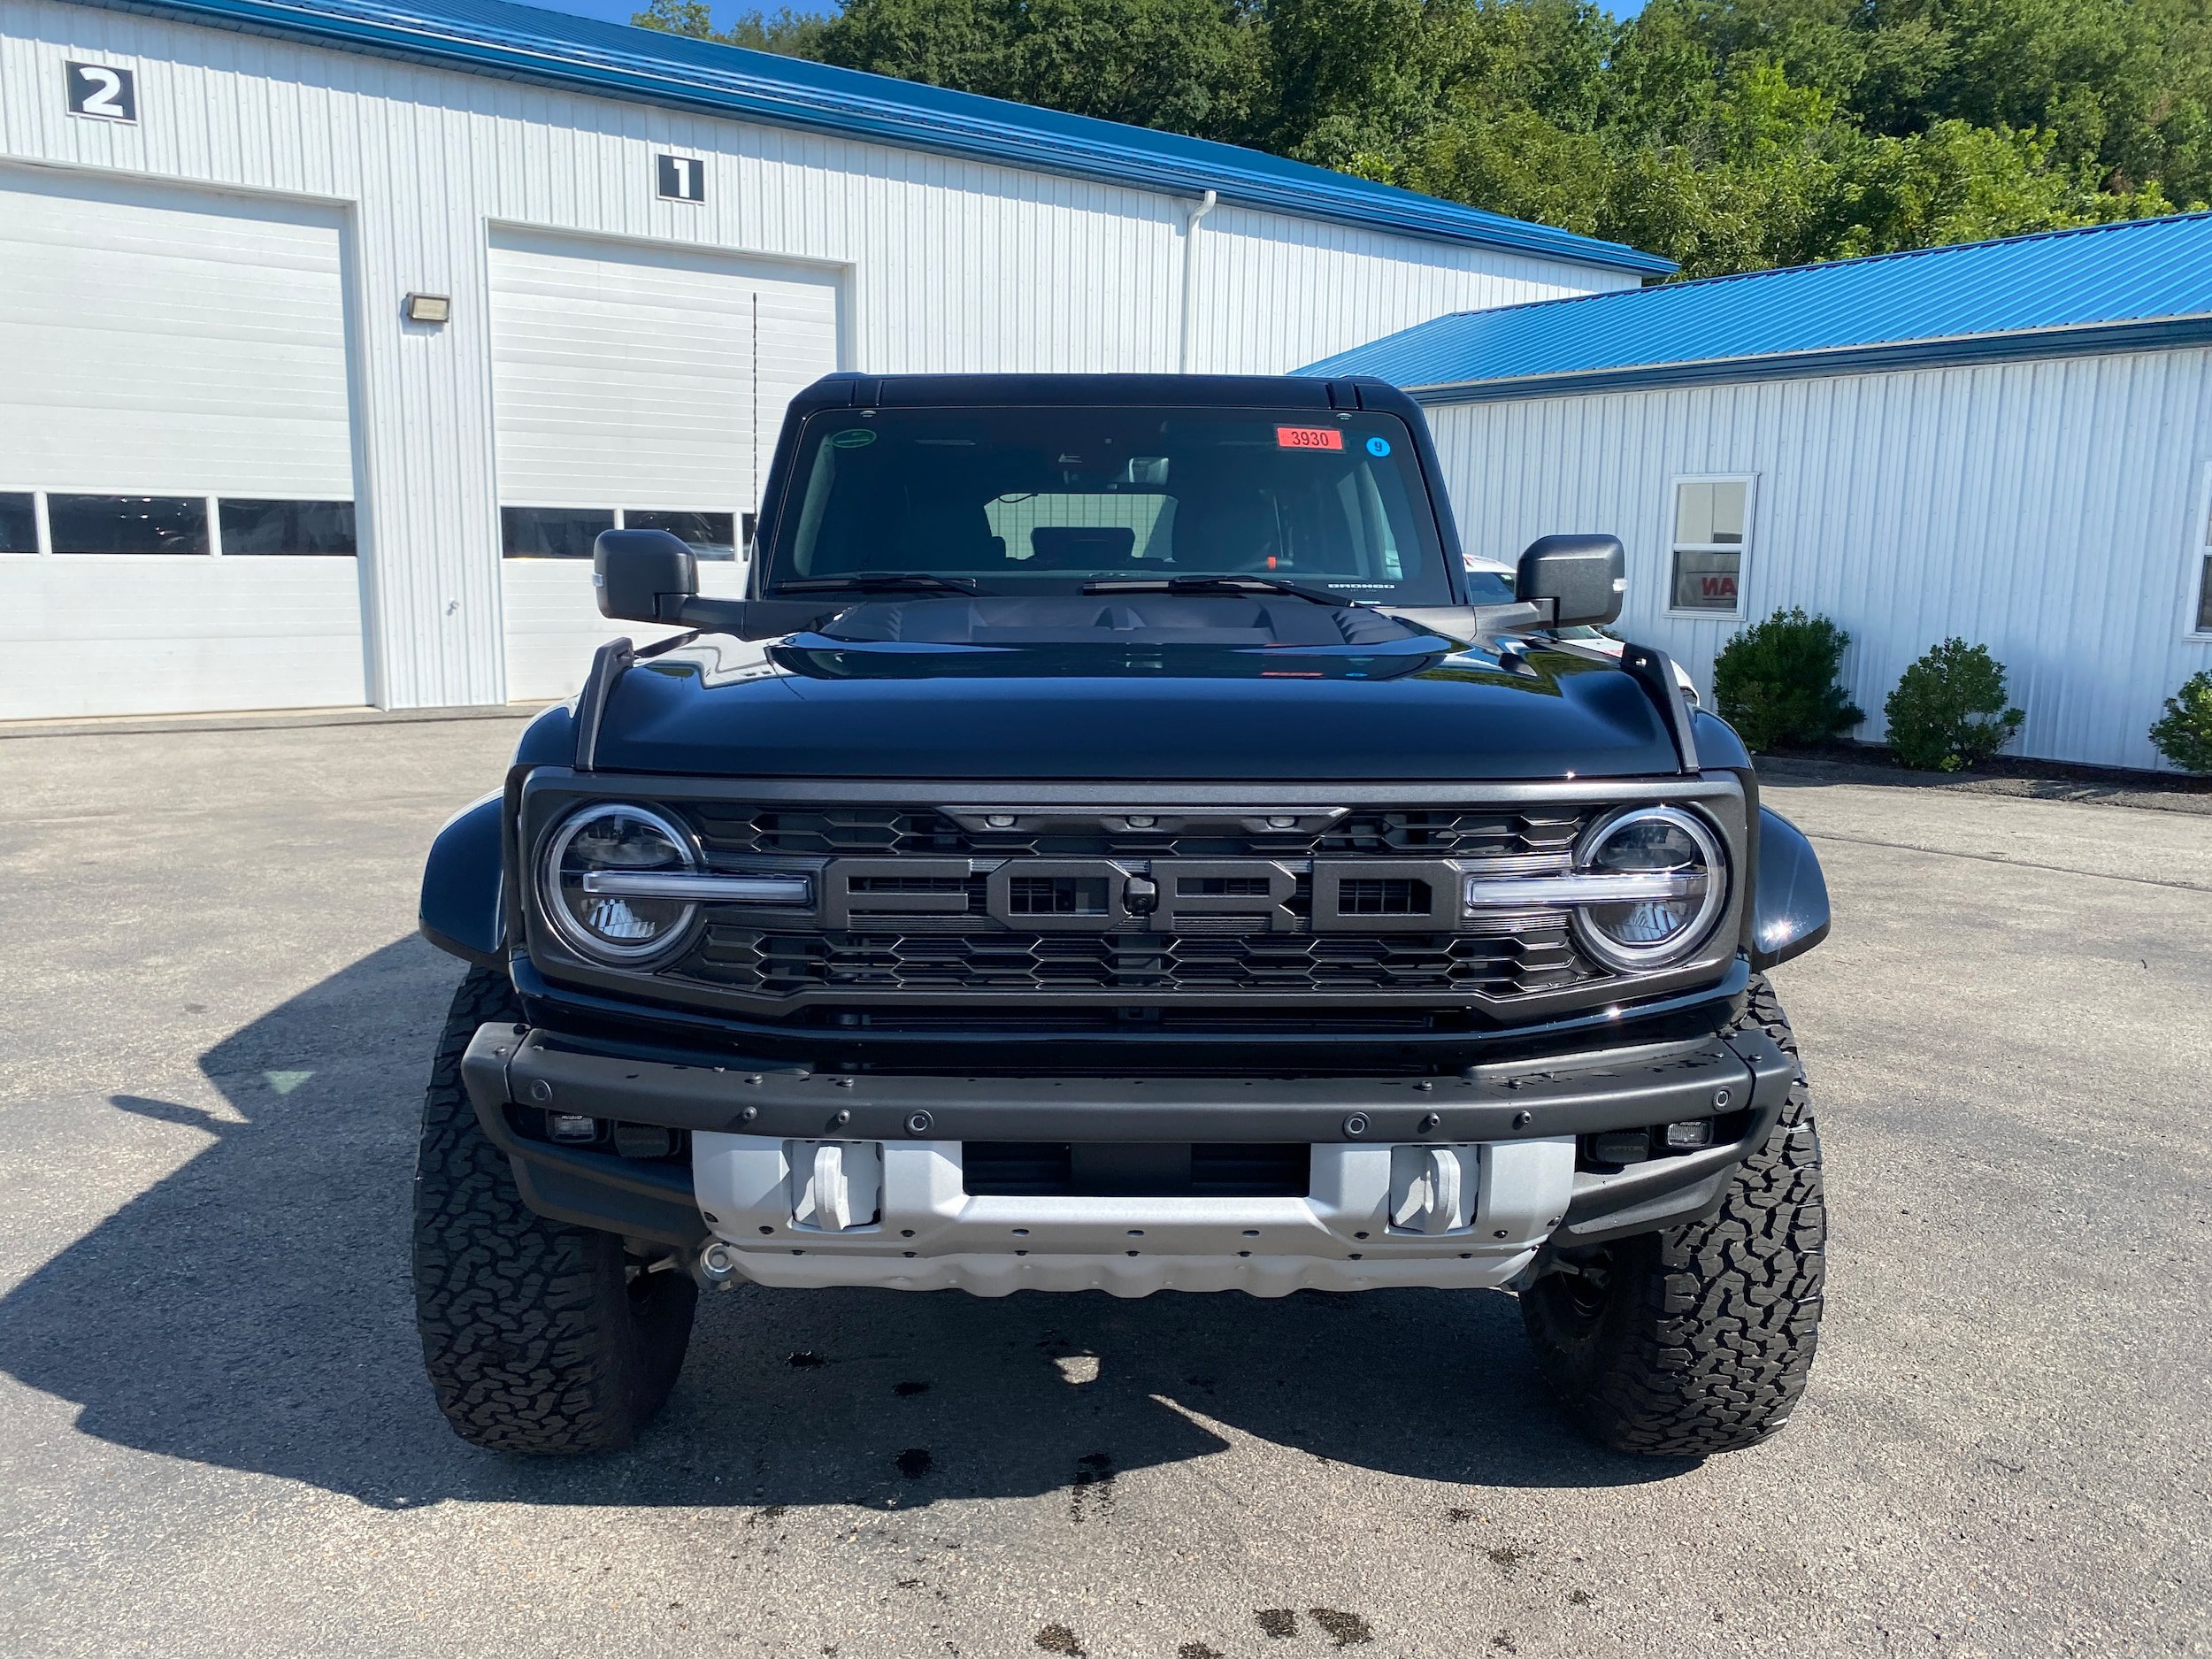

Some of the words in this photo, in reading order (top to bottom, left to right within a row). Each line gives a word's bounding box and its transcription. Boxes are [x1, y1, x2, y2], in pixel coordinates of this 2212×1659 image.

[79, 67, 124, 117] 2
[673, 159, 690, 198] 1
[1292, 431, 1329, 446] 3930
[1374, 441, 1383, 452] 9
[824, 858, 1459, 933] FORD
